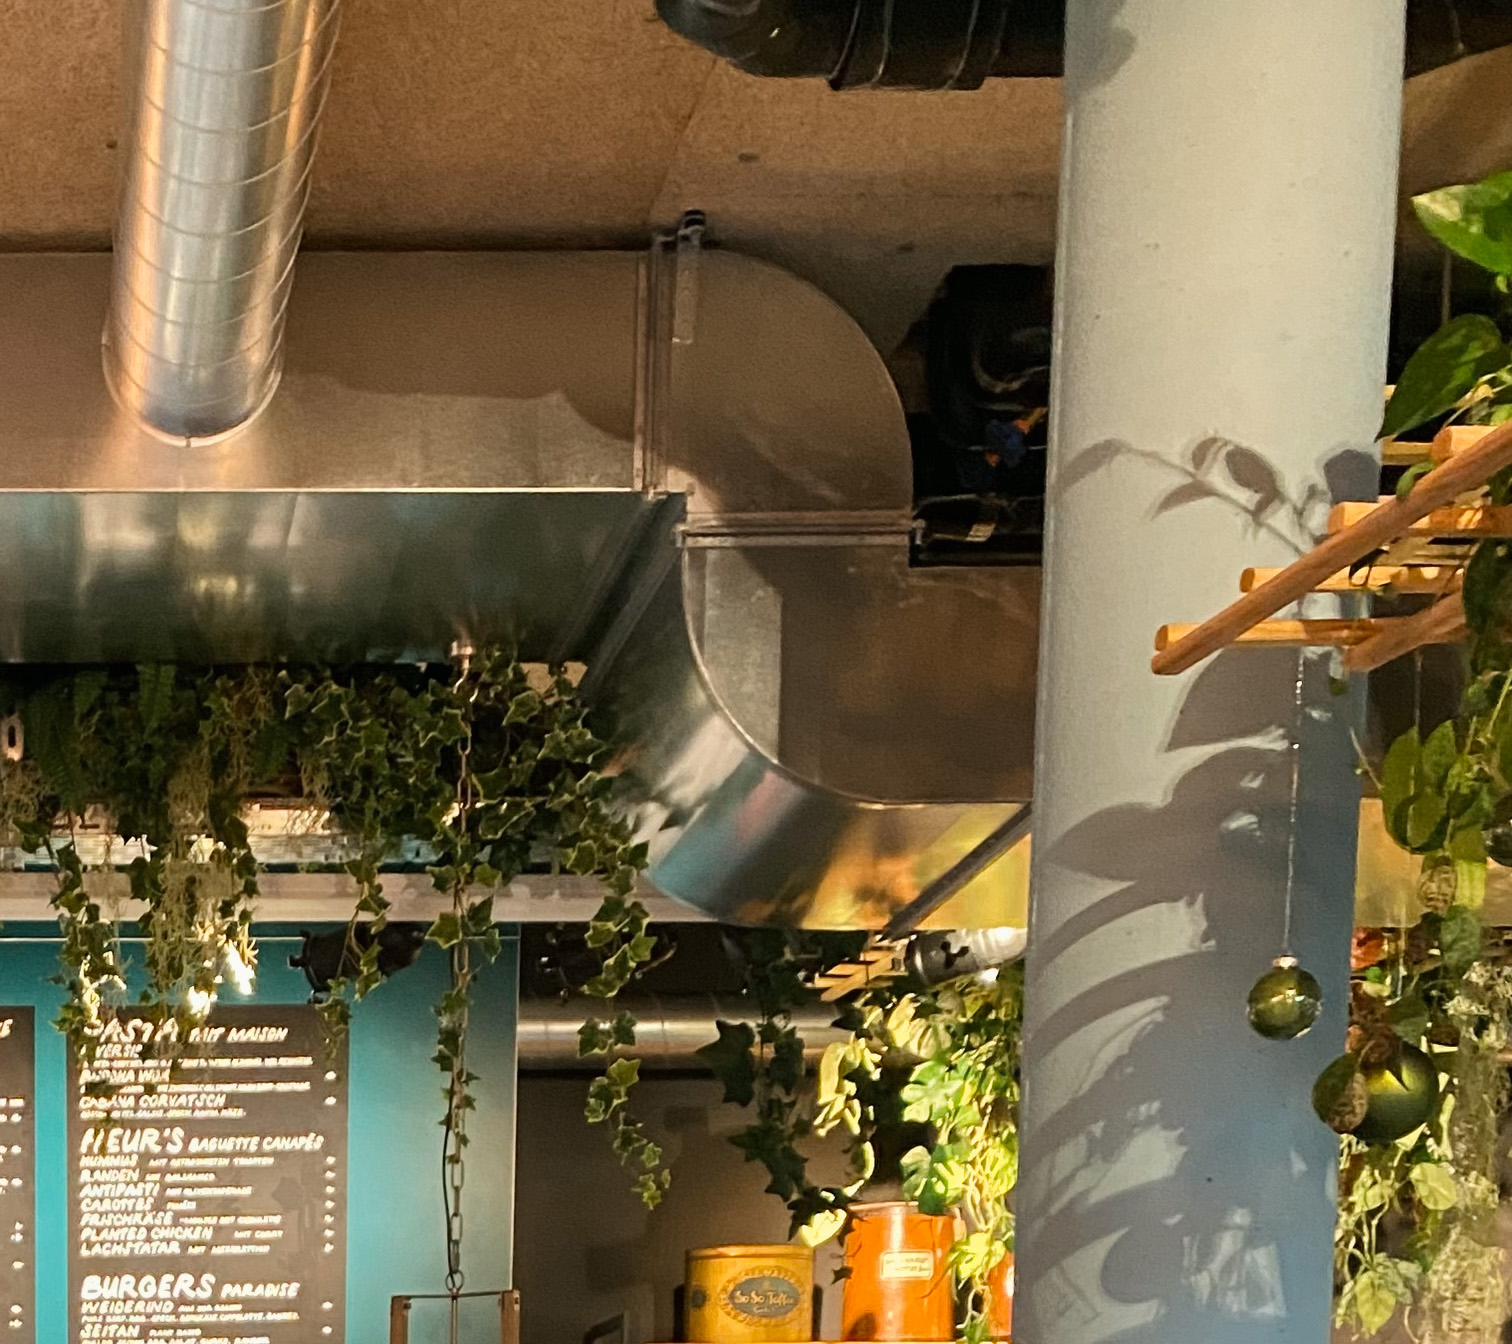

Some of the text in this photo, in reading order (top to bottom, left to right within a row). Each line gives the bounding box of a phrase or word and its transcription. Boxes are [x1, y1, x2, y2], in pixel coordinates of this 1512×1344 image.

[227, 1026, 288, 1043] MAISON
[139, 1094, 226, 1108] CORVATSCH
[189, 1137, 260, 1153] BAGUETTE
[262, 1133, 325, 1151] CANAPÉS
[80, 1169, 139, 1182] RANDEN
[79, 1183, 160, 1198] ANTIPASTI
[80, 1211, 174, 1226] FRISCHKÄSE
[80, 1227, 147, 1241] PLANTED
[151, 1227, 213, 1241] CHICKEN
[80, 1273, 300, 1299] BURGERS PARADISE
[80, 1324, 140, 1338] SEITAN
